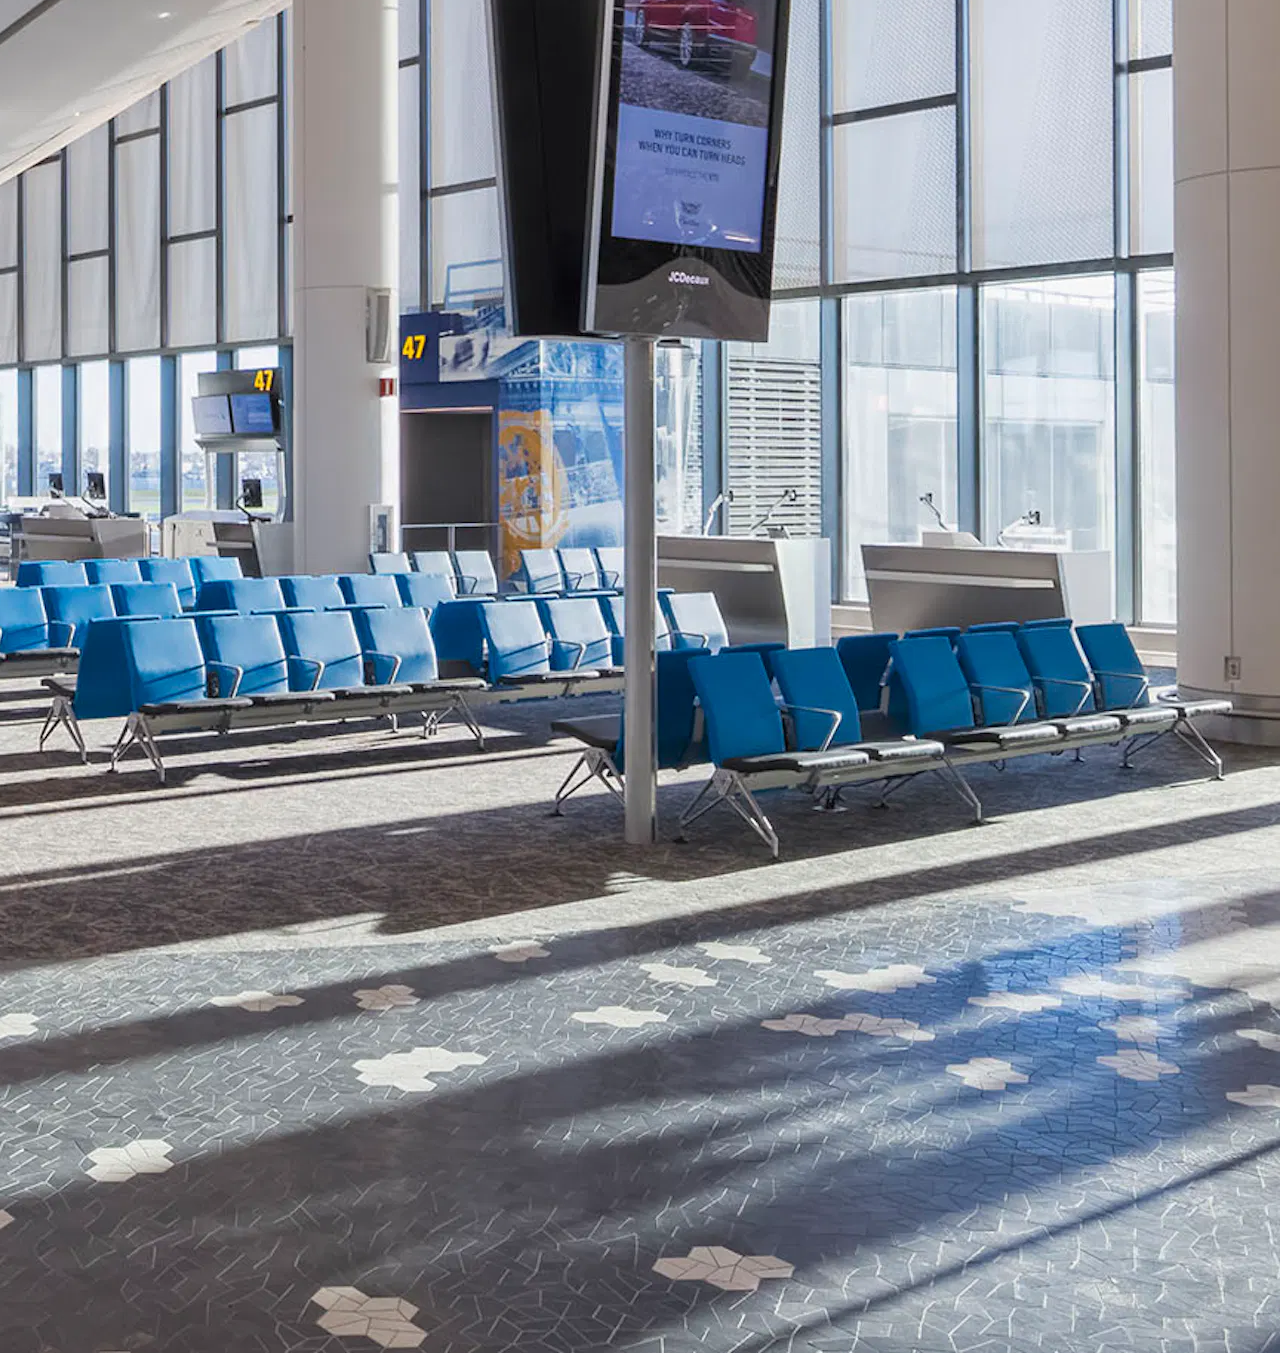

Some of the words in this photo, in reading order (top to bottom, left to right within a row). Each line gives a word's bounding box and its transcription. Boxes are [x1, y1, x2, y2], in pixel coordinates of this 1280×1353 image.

[654, 129, 672, 141] WHY
[674, 132, 695, 144] TURN
[696, 135, 732, 150] CORNERS
[638, 140, 663, 153] WHEN
[665, 144, 680, 156] YOU
[681, 147, 698, 159] CAN
[699, 149, 719, 162] TURN
[721, 153, 746, 166] HEADS
[668, 271, 710, 285] JCDecaux
[402, 335, 426, 360] 47
[254, 370, 274, 391] 47
